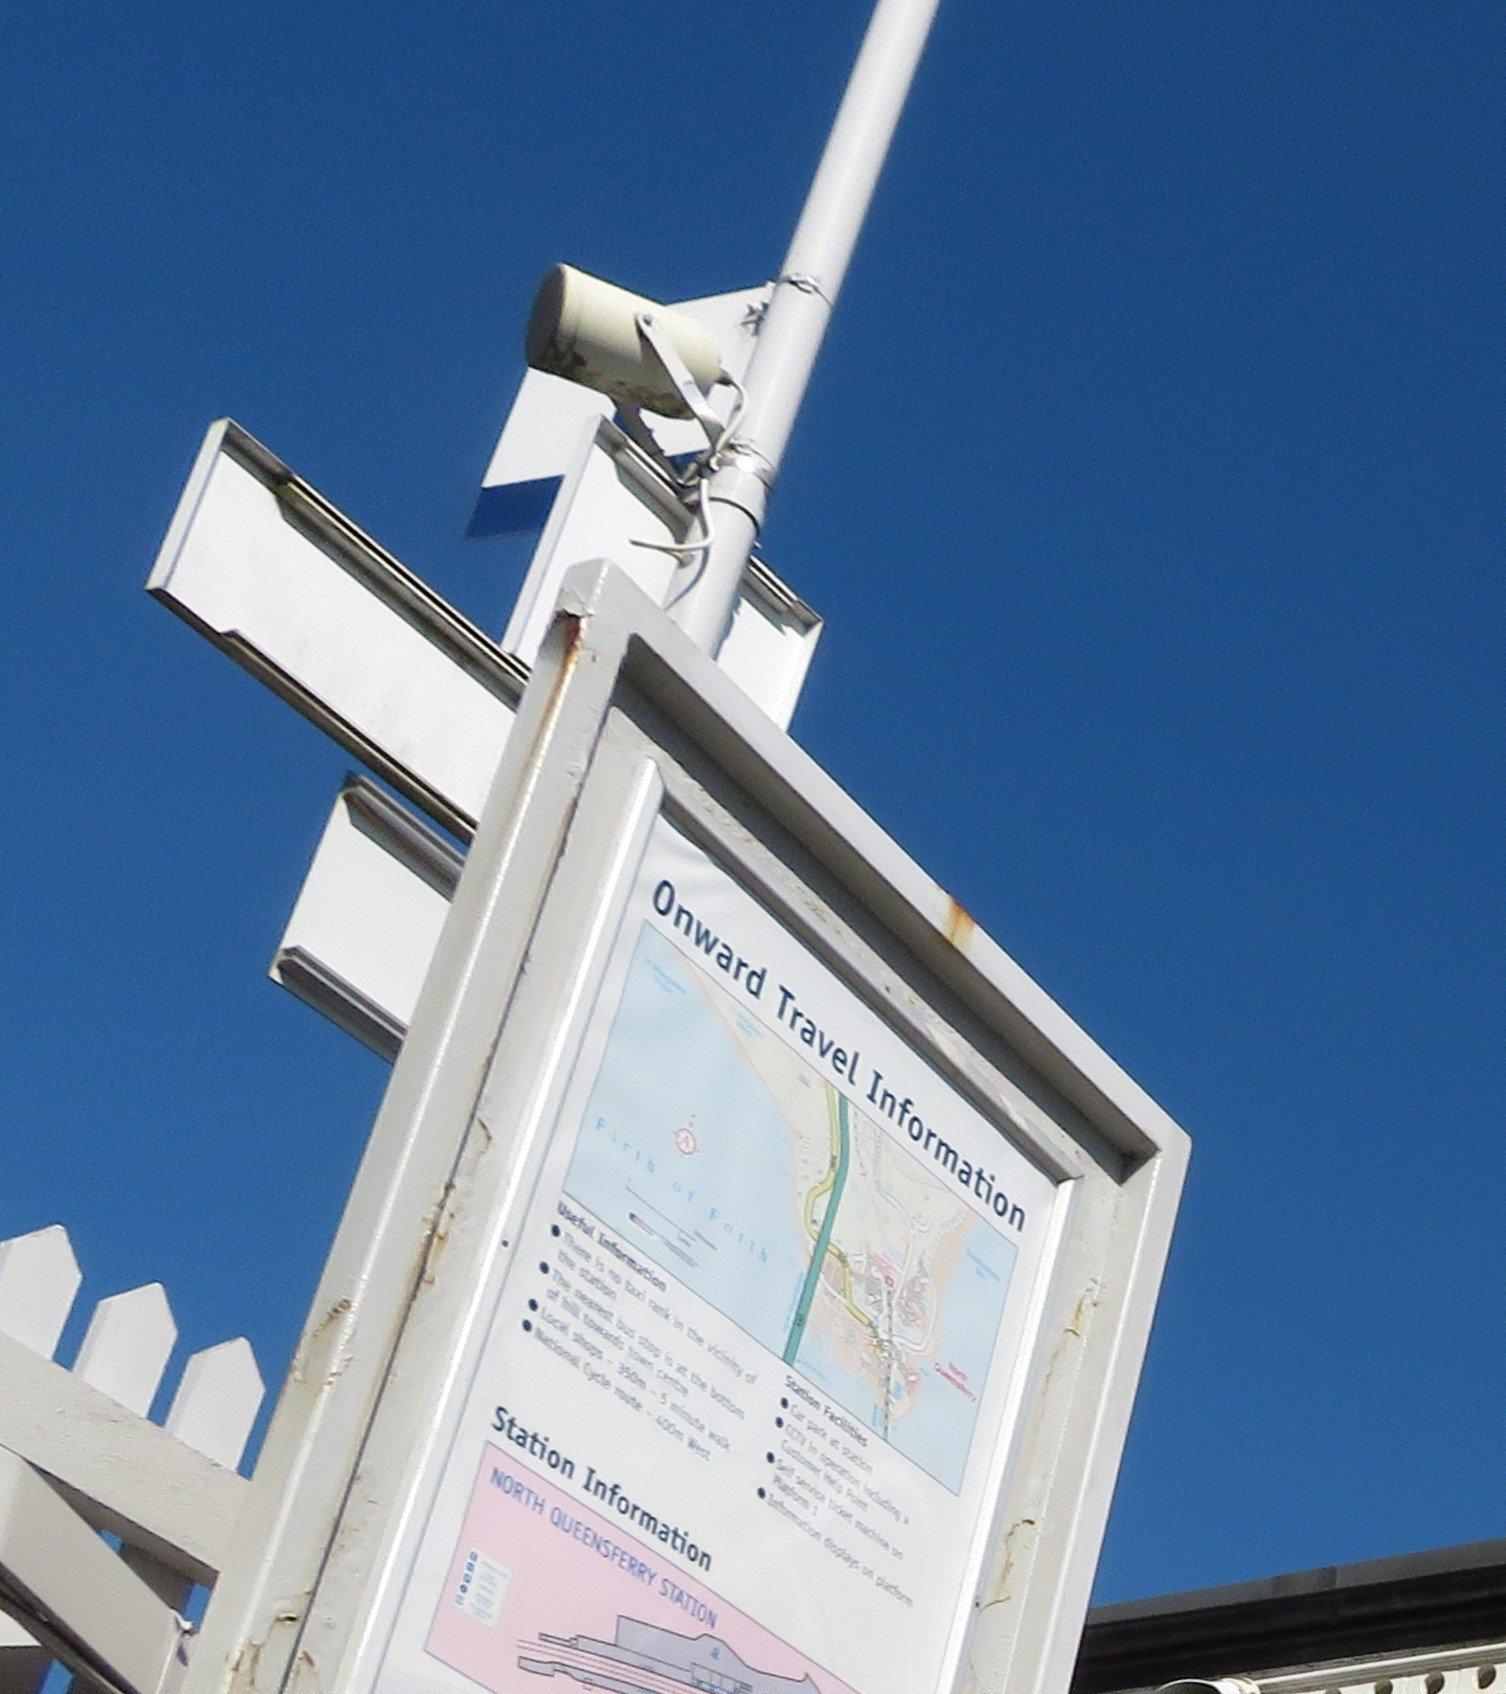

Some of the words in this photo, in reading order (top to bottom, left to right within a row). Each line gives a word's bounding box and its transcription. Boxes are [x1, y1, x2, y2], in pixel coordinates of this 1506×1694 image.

[652, 879, 767, 1000] Onward
[777, 984, 859, 1086] Travel
[867, 1069, 1026, 1233] Information
[557, 1200, 595, 1238] Useful
[598, 1232, 667, 1292] Information
[492, 1405, 576, 1479] Station
[582, 1465, 712, 1572] Information
[785, 1374, 821, 1410] Station
[823, 1404, 868, 1447] Facilities
[489, 1467, 546, 1515] NORTH
[550, 1506, 658, 1586] QUEENSFERRY
[659, 1577, 718, 1630] STATION
